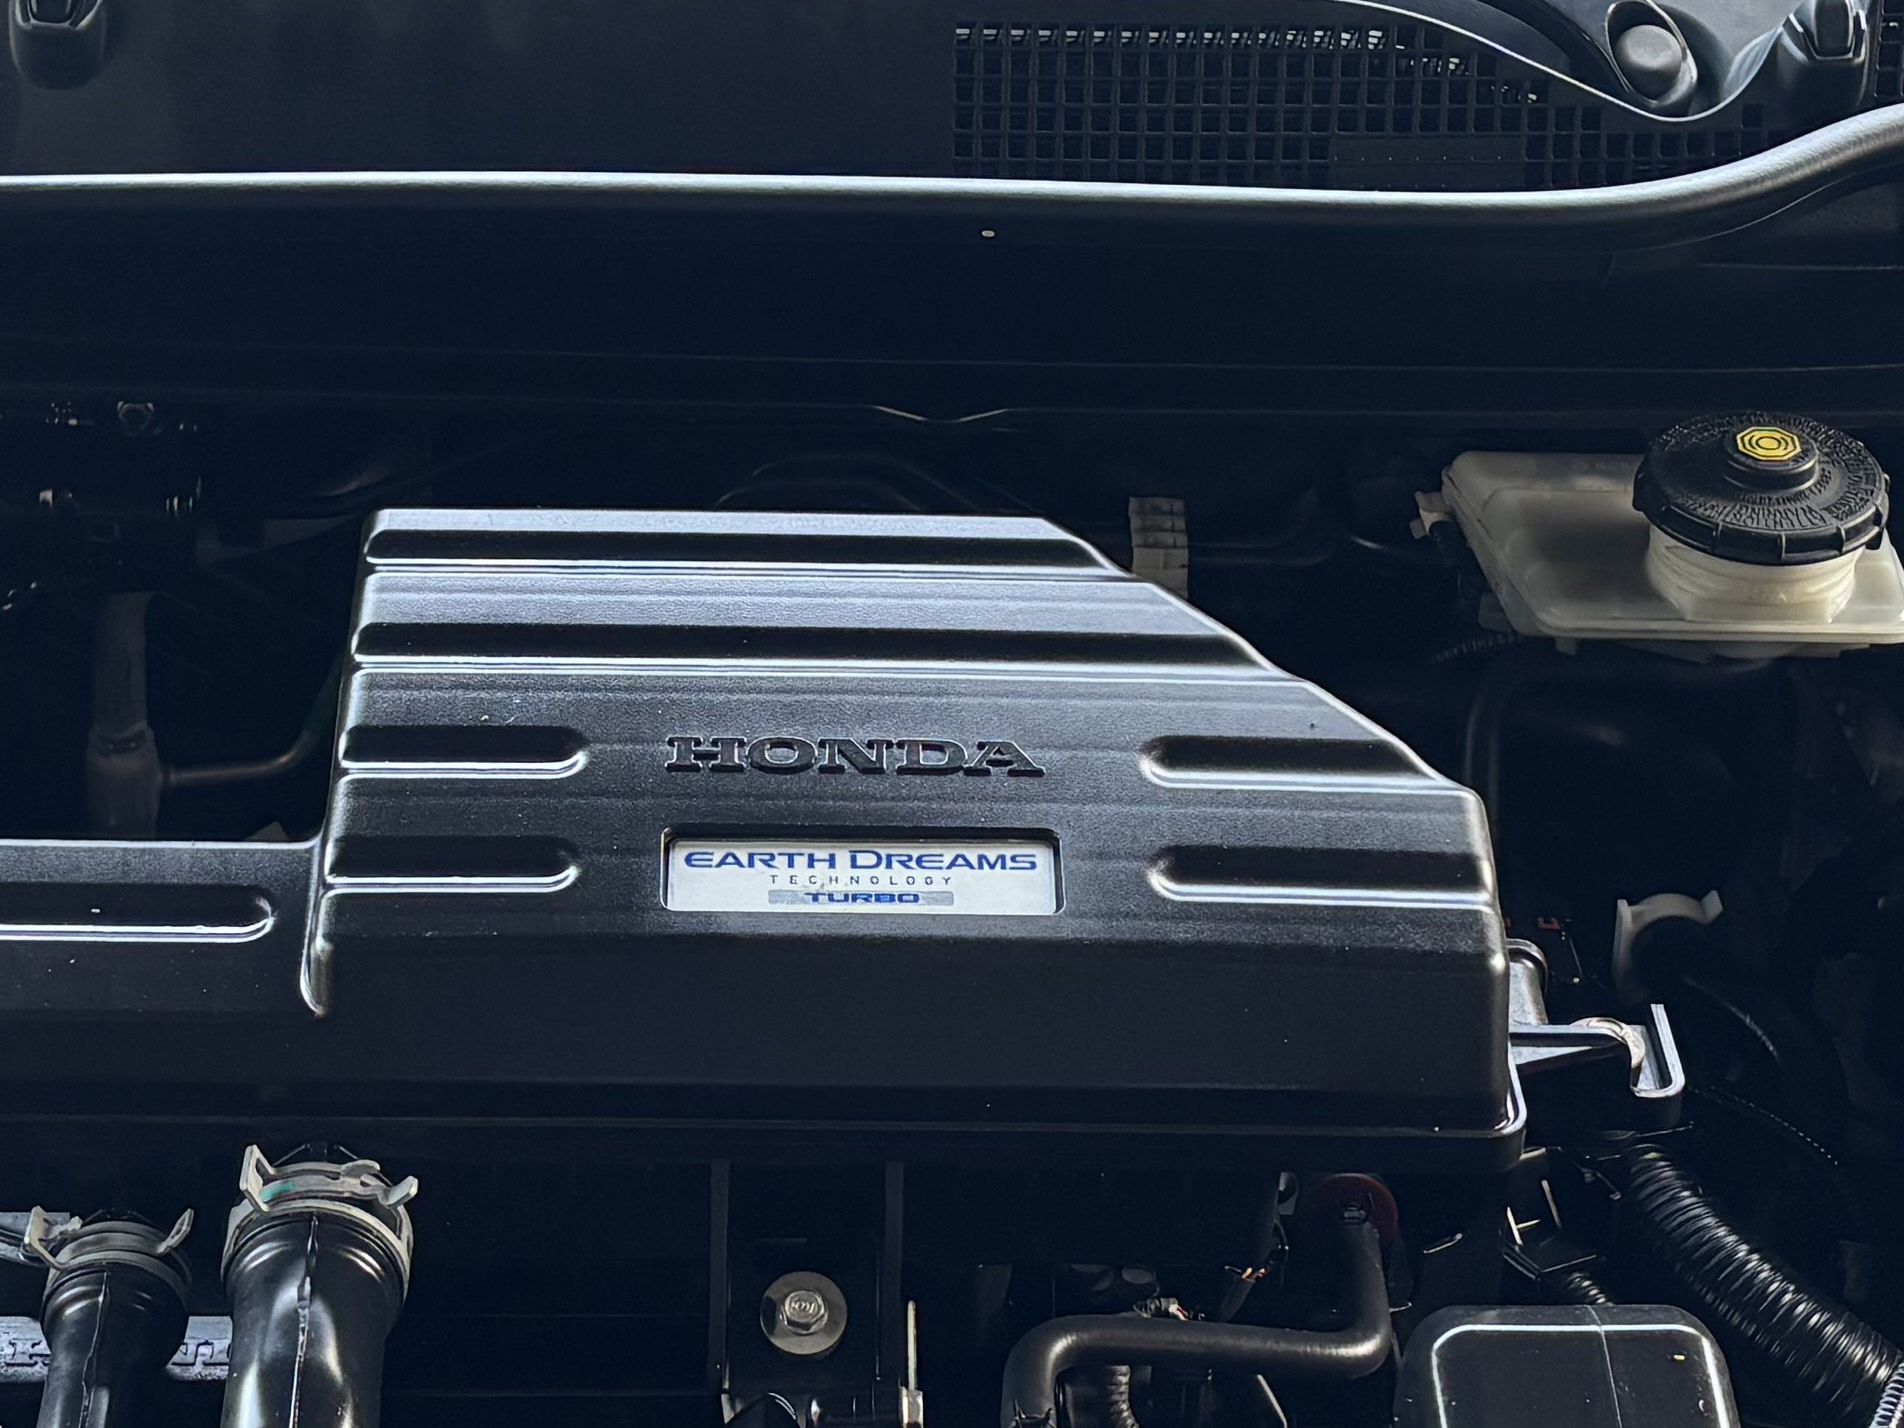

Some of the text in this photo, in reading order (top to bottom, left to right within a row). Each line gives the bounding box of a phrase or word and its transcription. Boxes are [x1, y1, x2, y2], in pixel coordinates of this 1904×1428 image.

[665, 735, 1046, 777] HONDA
[683, 849, 1038, 871] EARTH DREAMS
[769, 875, 952, 886] TECHNOLOGY
[802, 892, 920, 904] TURBO
